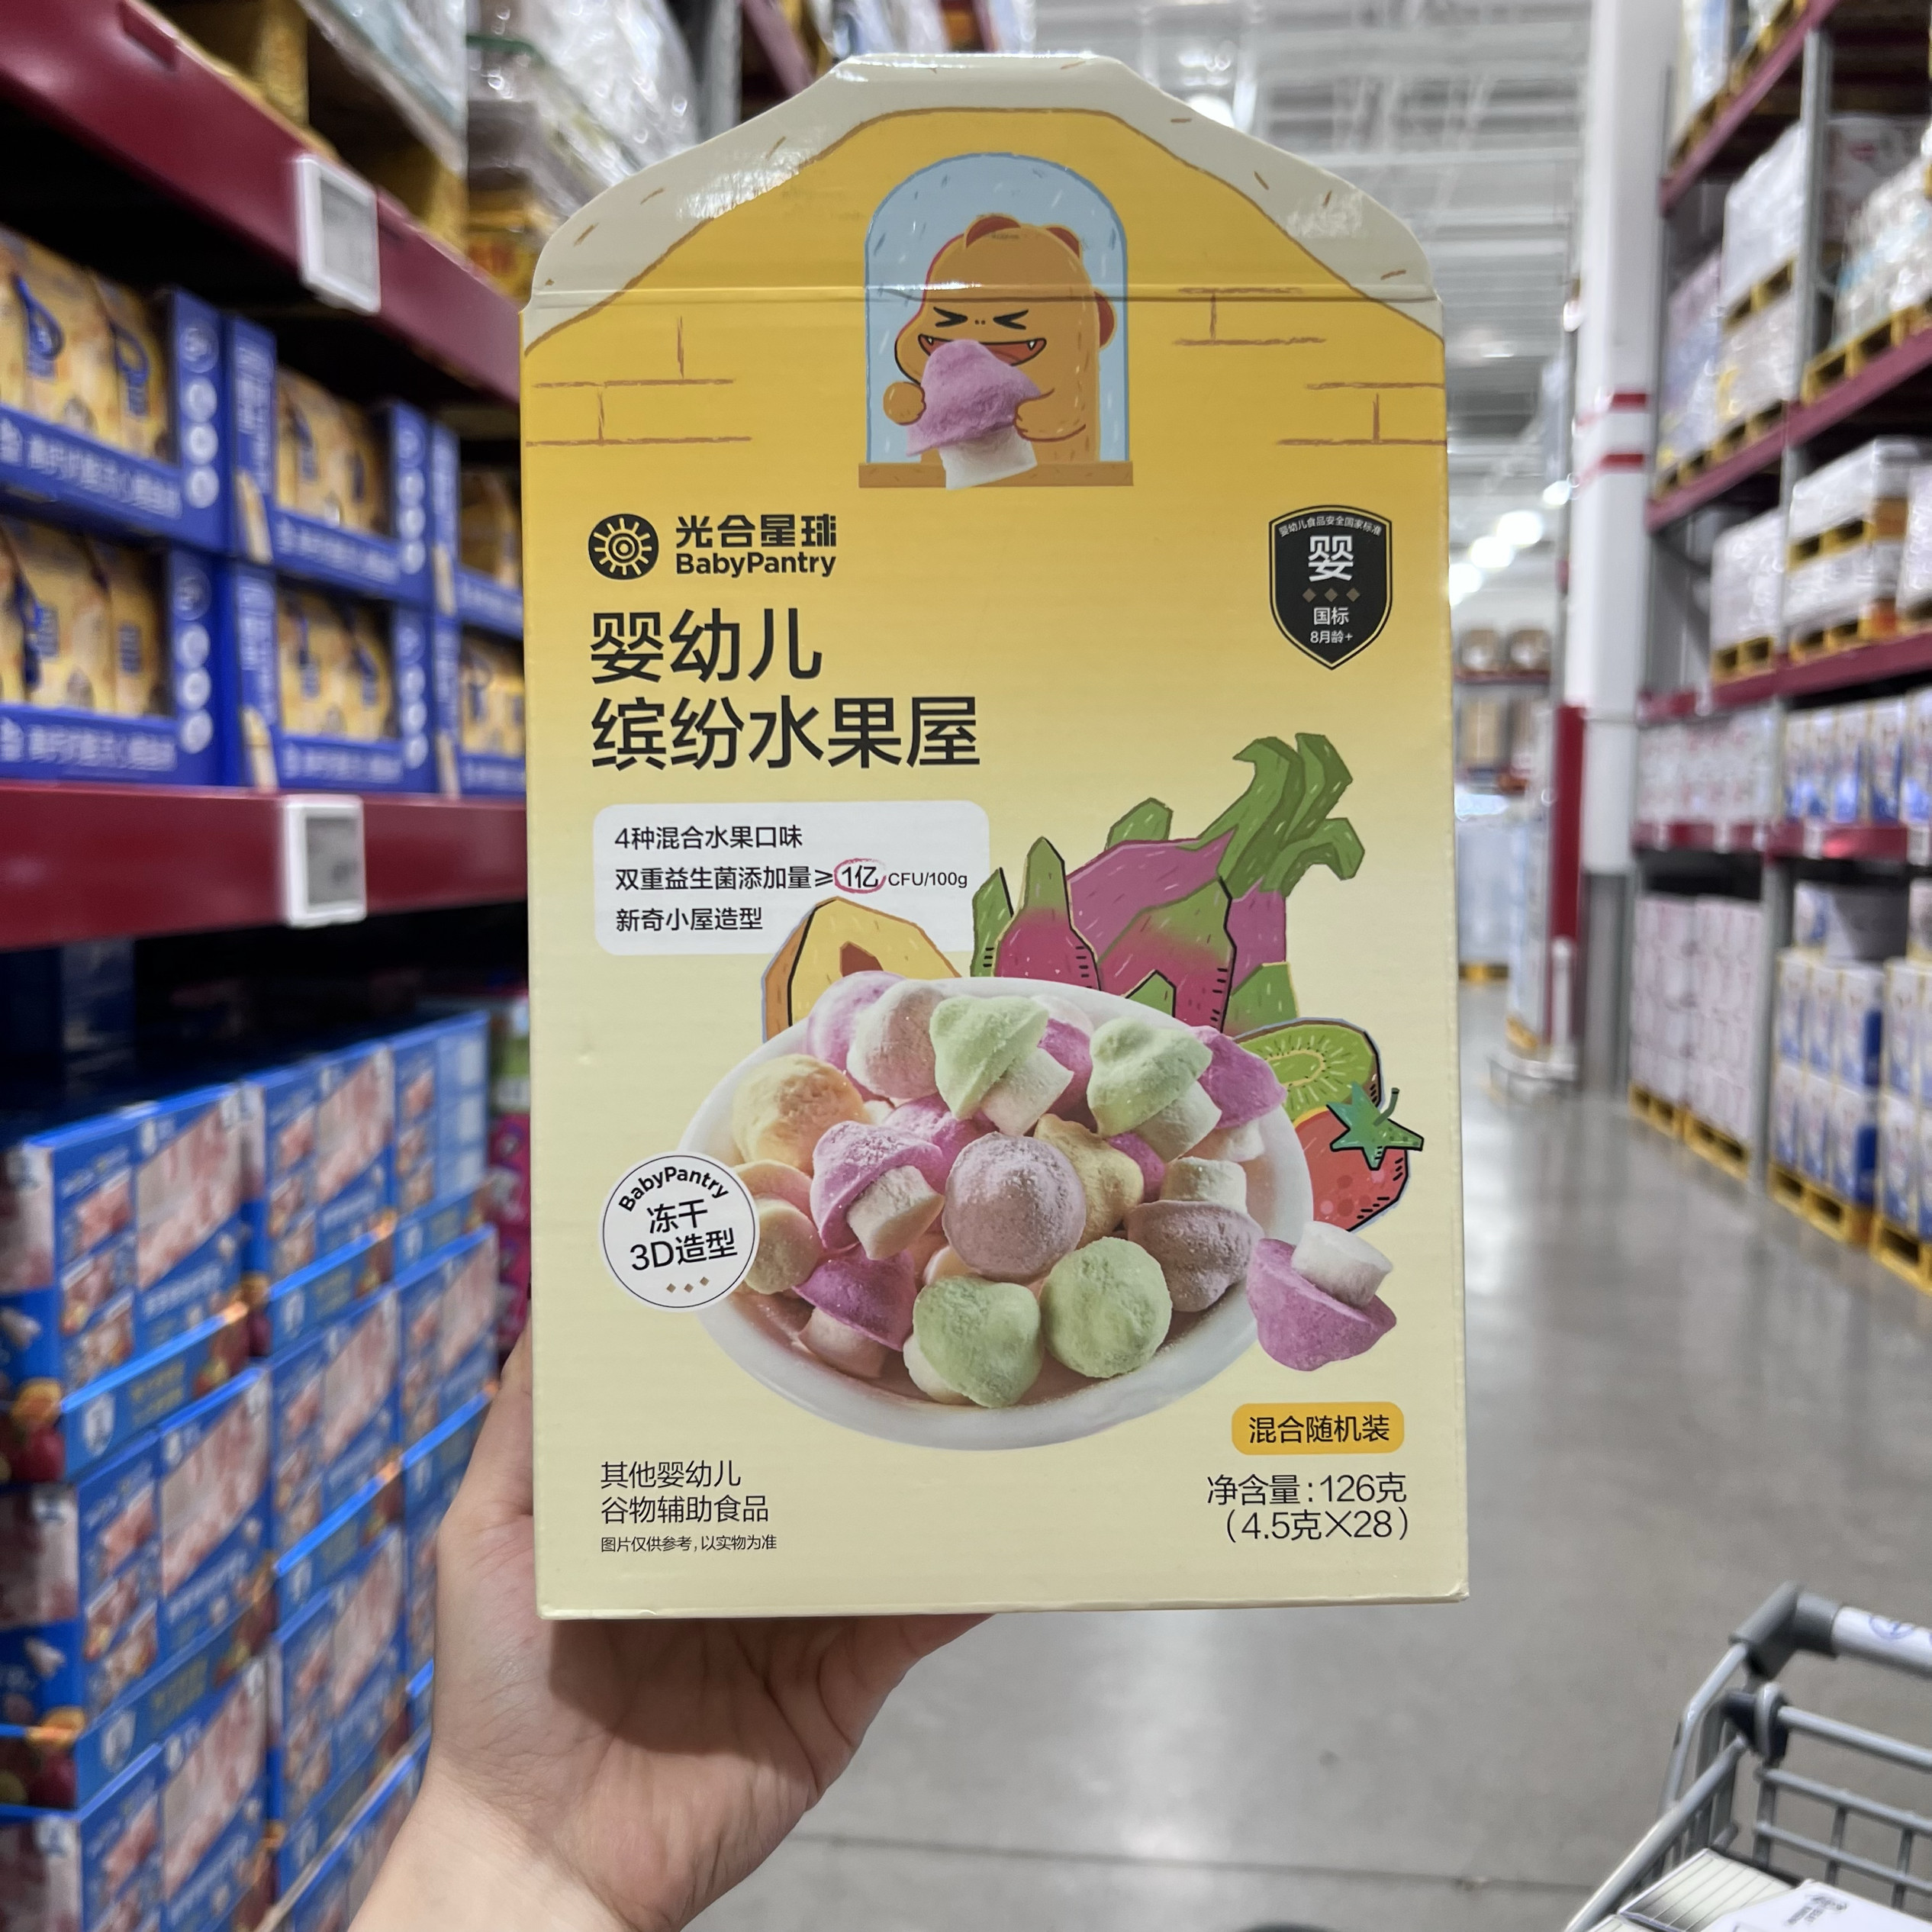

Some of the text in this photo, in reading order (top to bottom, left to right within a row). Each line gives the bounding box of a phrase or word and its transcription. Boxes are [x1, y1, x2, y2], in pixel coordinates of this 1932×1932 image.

[676, 514, 836, 548] 光合星球
[676, 551, 836, 578] BabyPantry
[1308, 536, 1354, 581] 婴
[1313, 607, 1349, 625] 国标
[591, 608, 823, 684] 婴幼儿
[1310, 630, 1353, 643] 8月龄+
[591, 695, 980, 771] 缤纷水果屋
[614, 825, 803, 849] 4种混合水果口味
[616, 907, 763, 932] 新奇小屋造型
[618, 1166, 729, 1212] BabyPantry
[647, 1199, 707, 1233] 冻干
[630, 1228, 738, 1270] 3D造型
[1248, 1415, 1389, 1444] 混合随机装
[601, 1460, 742, 1489] 其他婴幼儿
[1206, 1472, 1407, 1505] 净含量:126克
[601, 1495, 768, 1524] 谷物辅助食品
[601, 1534, 777, 1552] 图片仅供参考,以实物为准
